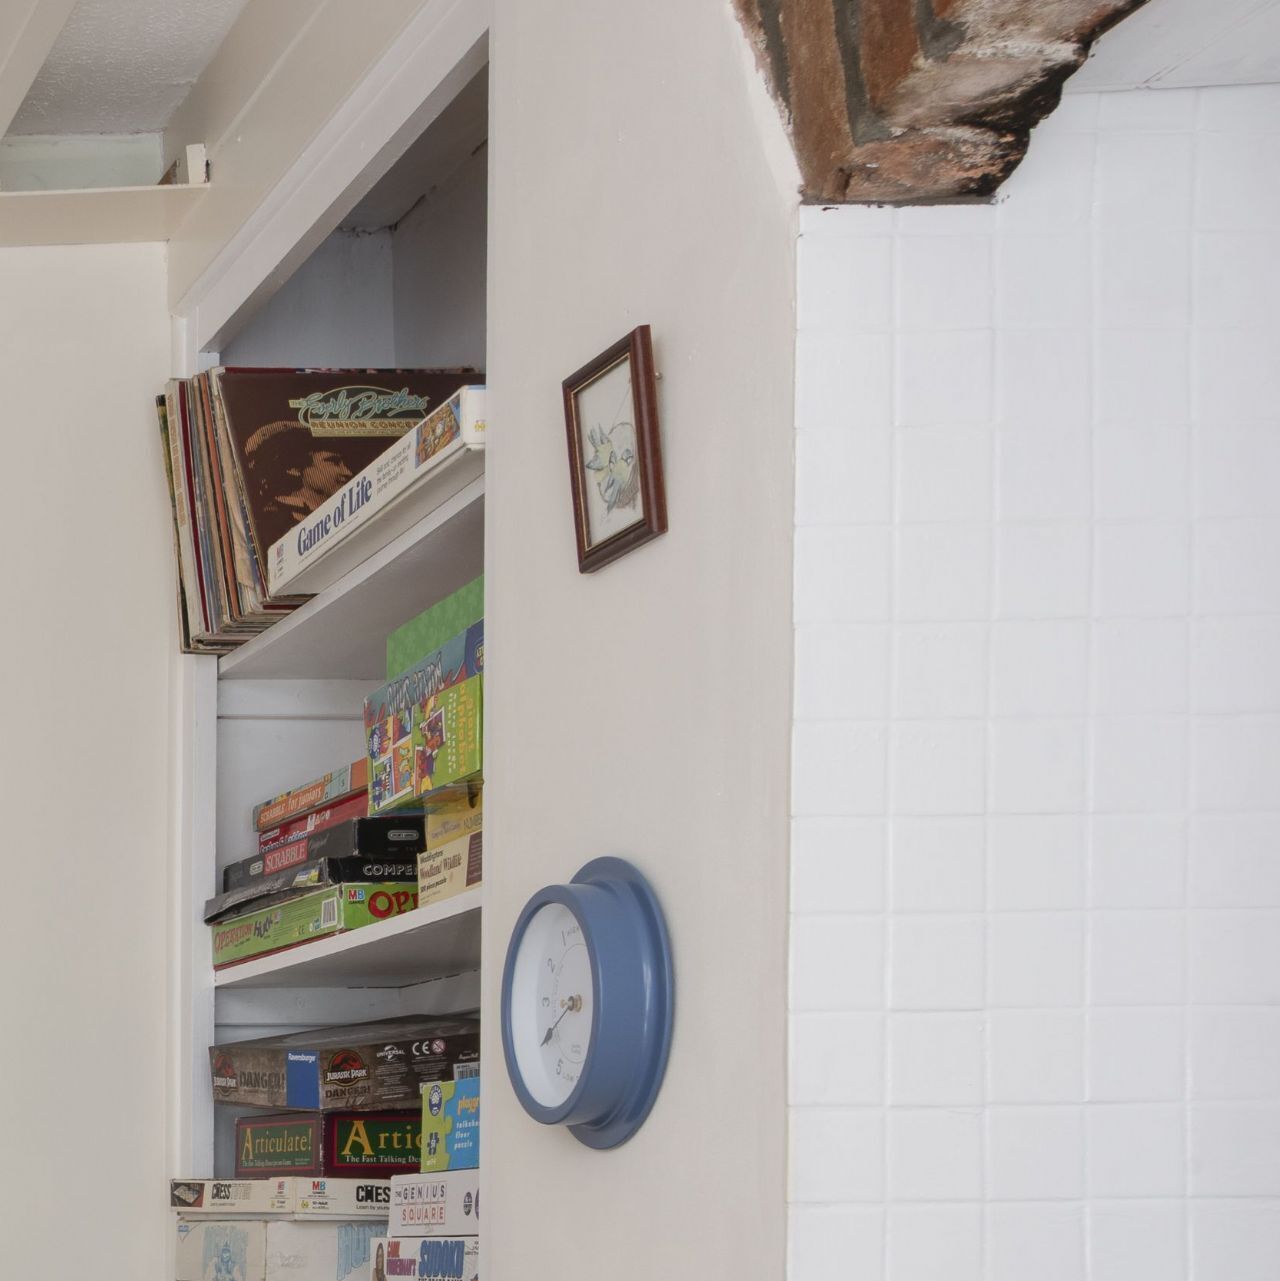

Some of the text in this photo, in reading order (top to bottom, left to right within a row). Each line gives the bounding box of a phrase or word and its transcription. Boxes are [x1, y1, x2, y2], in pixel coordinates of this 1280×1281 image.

[297, 475, 373, 557] Game of Life
[266, 842, 306, 872] SCRABBLE
[363, 864, 418, 876] COMPE
[348, 889, 365, 901] MB
[542, 997, 550, 1008] 3
[288, 1053, 316, 1063] Ravensburger
[326, 1068, 368, 1081] JURASSIC PARK
[241, 1127, 312, 1161] Articulate!
[346, 1155, 360, 1163] The
[362, 1155, 377, 1163] Fast
[379, 1155, 407, 1164] Talking
[312, 1180, 326, 1191] MB
[403, 1184, 445, 1200] GENIUS
[402, 1206, 444, 1222] SQUARE
[418, 1239, 465, 1280] SUDOKU
